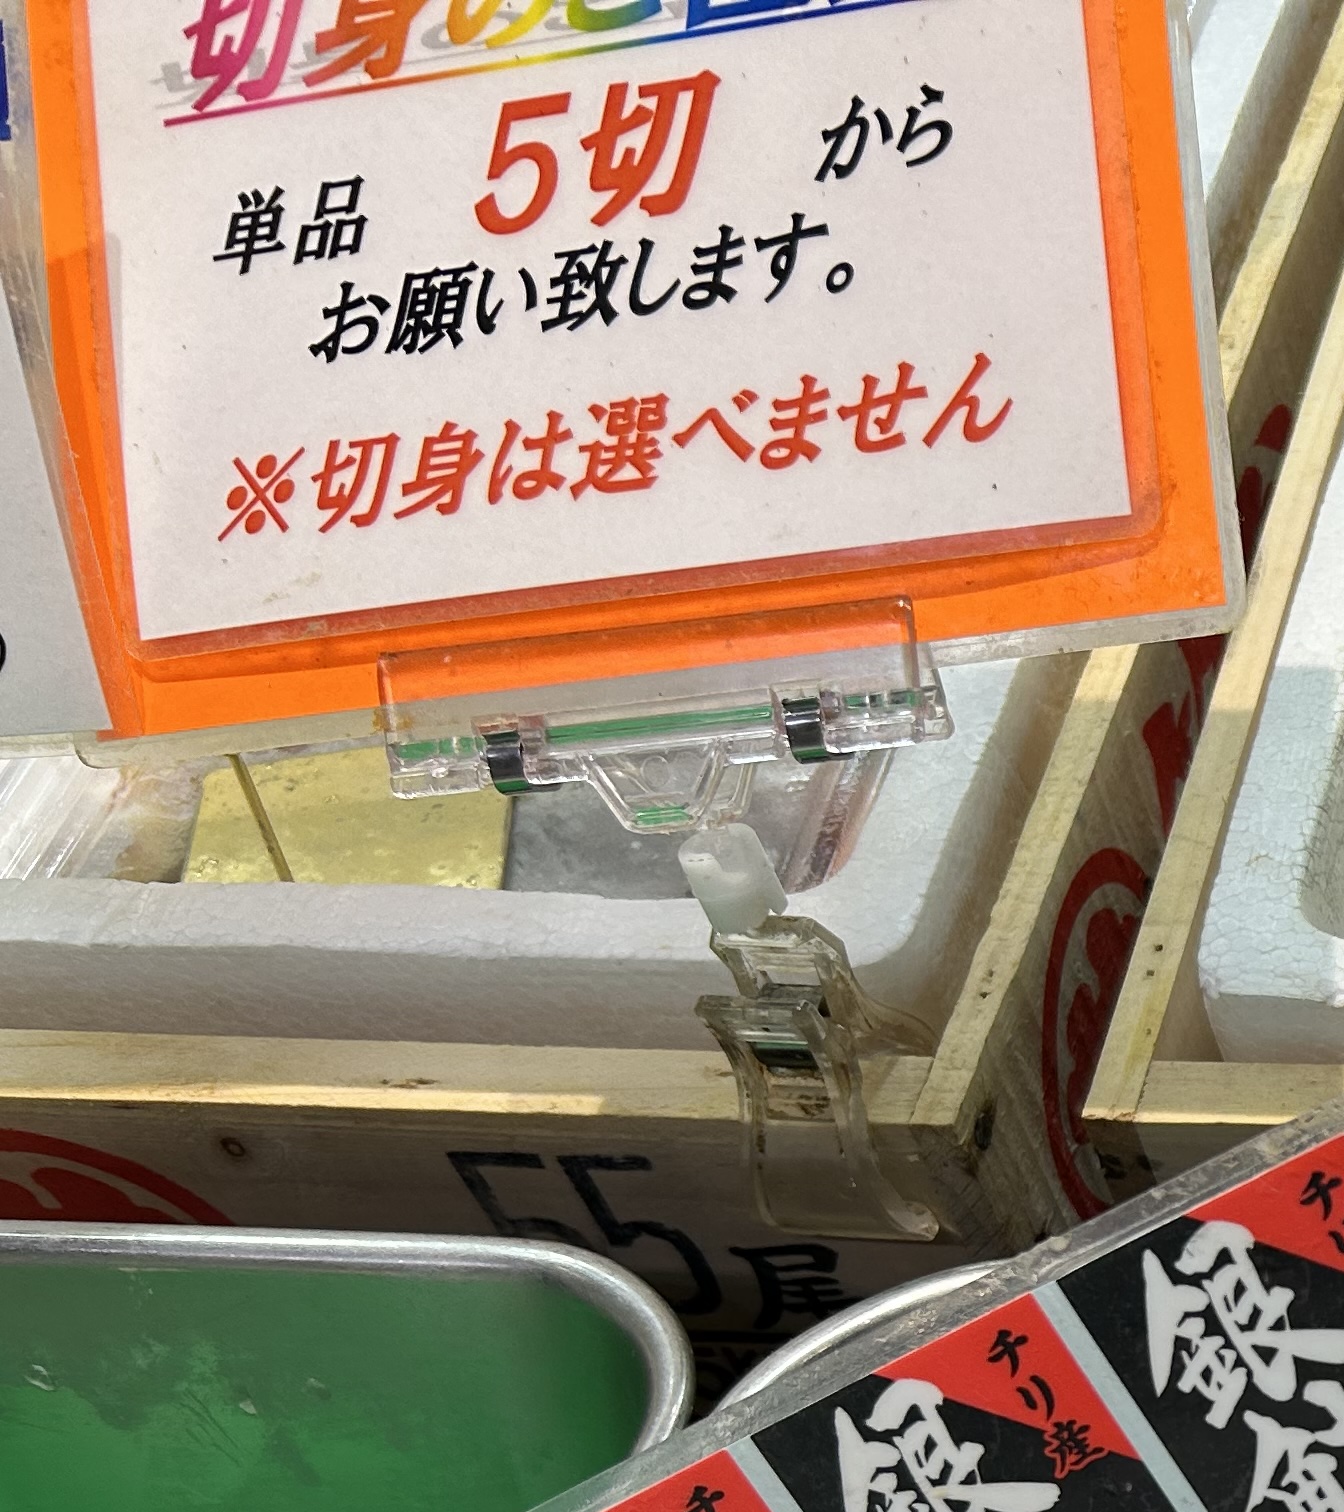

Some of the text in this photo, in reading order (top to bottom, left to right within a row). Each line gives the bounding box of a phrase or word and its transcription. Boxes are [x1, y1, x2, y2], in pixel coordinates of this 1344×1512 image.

[214, 69, 954, 275] 単品 5切 から
[307, 210, 857, 363] お願い致します。
[987, 1329, 1108, 1479] チリ産
